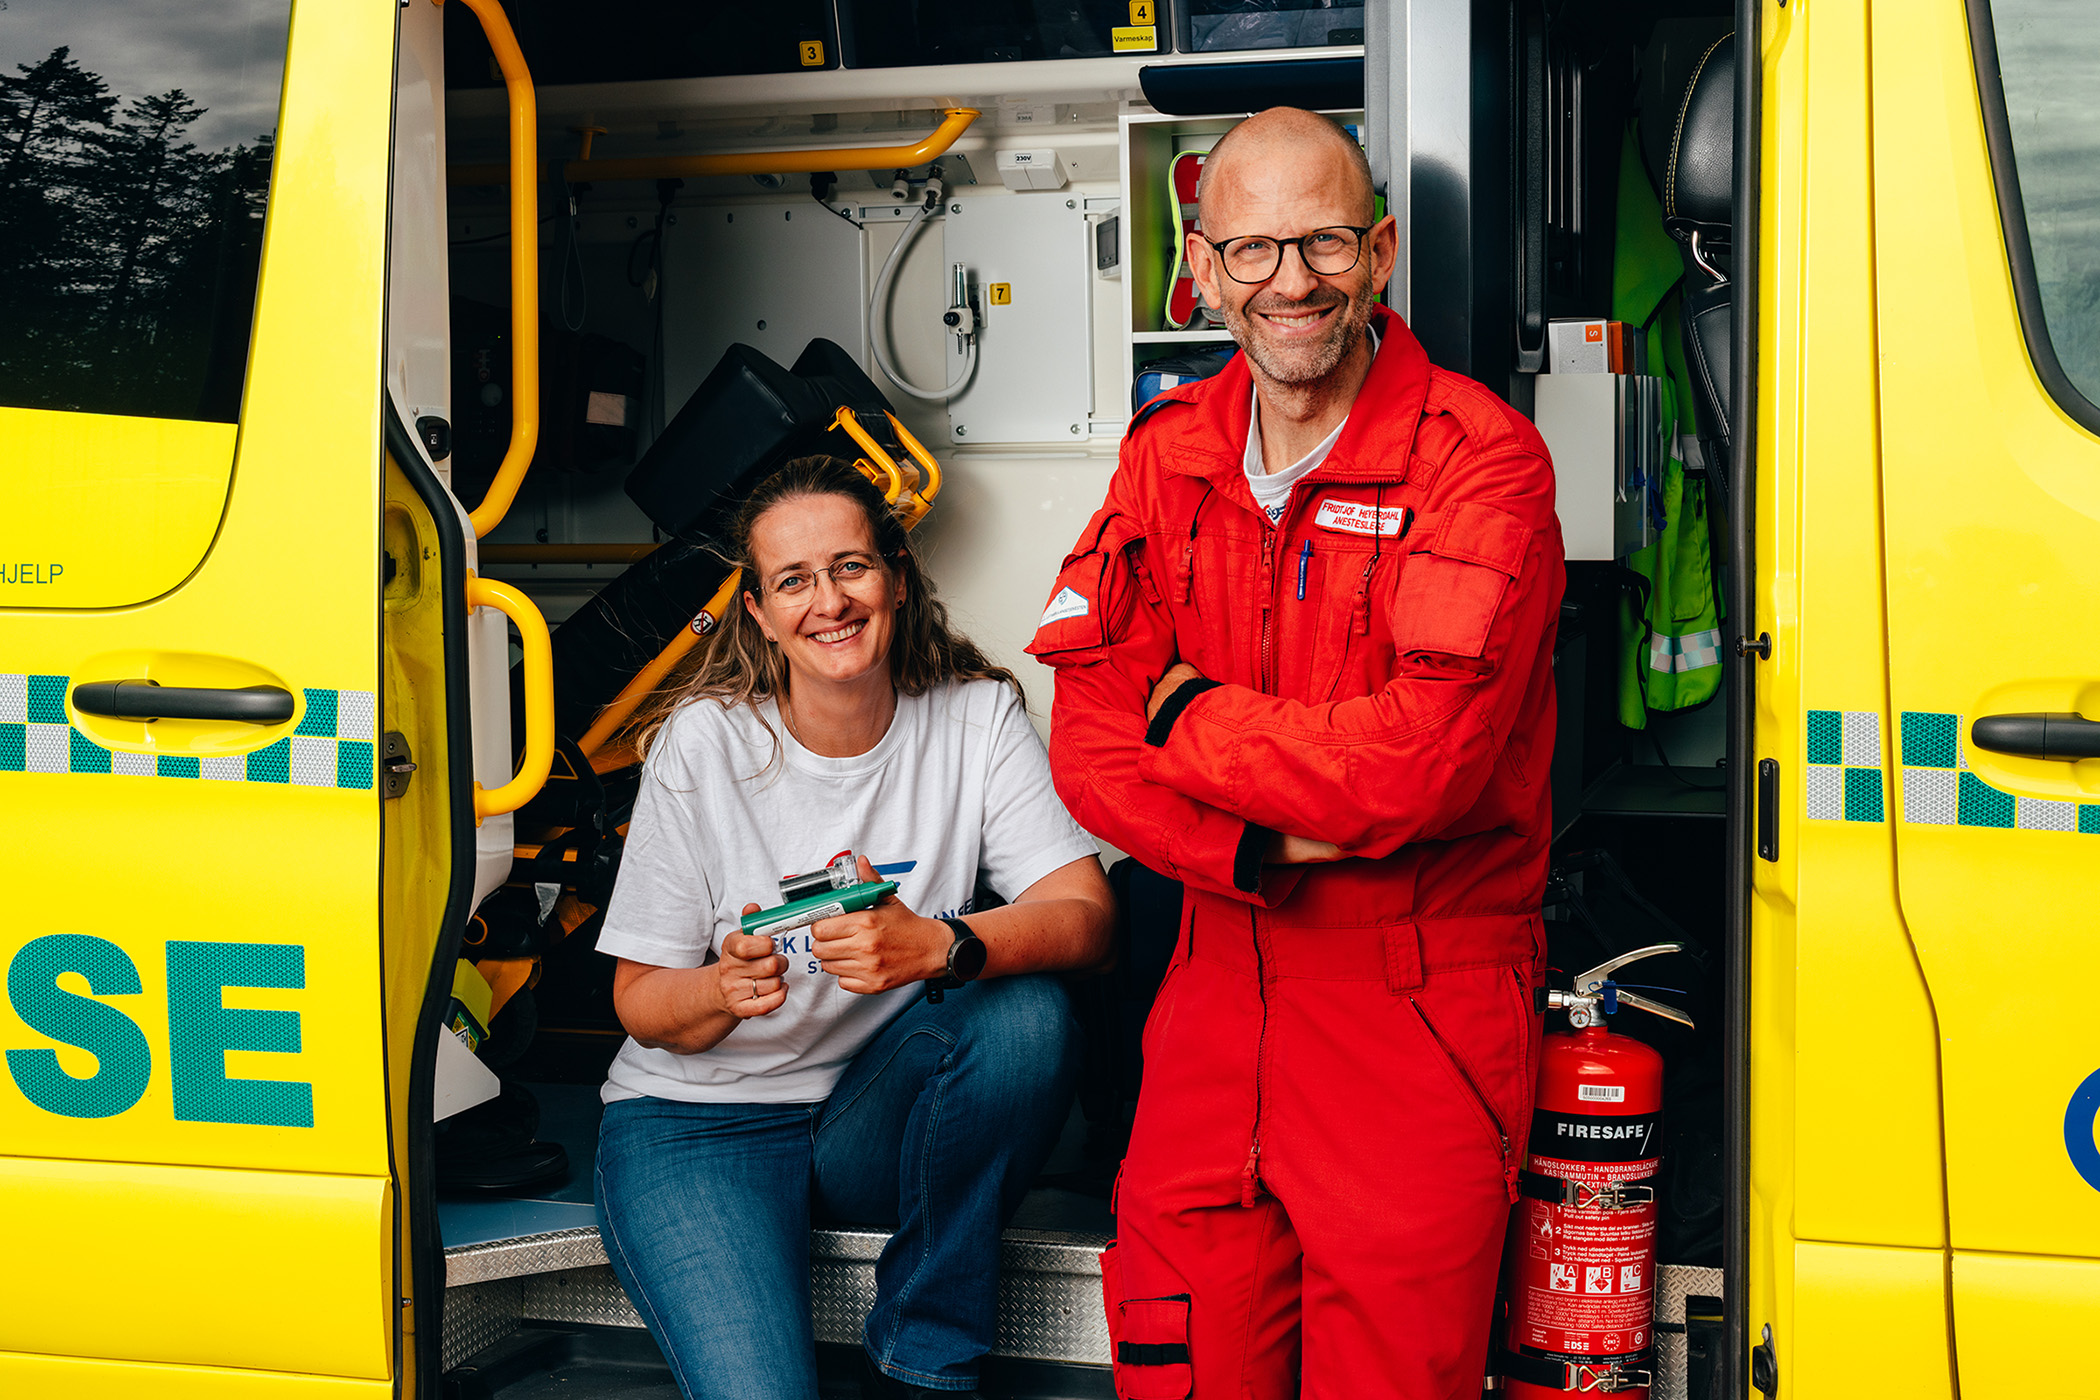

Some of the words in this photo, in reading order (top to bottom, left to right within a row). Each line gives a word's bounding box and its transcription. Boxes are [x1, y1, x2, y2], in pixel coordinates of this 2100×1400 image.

[1137, 5, 1147, 19] 4
[1114, 35, 1153, 43] Varmeskap
[807, 46, 817, 60] 3
[996, 288, 1005, 300] 7
[1321, 502, 1356, 516] FRIDTJOF
[1359, 509, 1400, 521] HEYERDAHL
[5, 933, 315, 1128] SE
[1557, 1122, 1644, 1139] FIRESAFE
[1555, 1248, 1561, 1256] 3
[1566, 1265, 1576, 1276] A
[1602, 1267, 1612, 1278] B
[1633, 1264, 1641, 1276] C
[1571, 1340, 1582, 1350] DS
